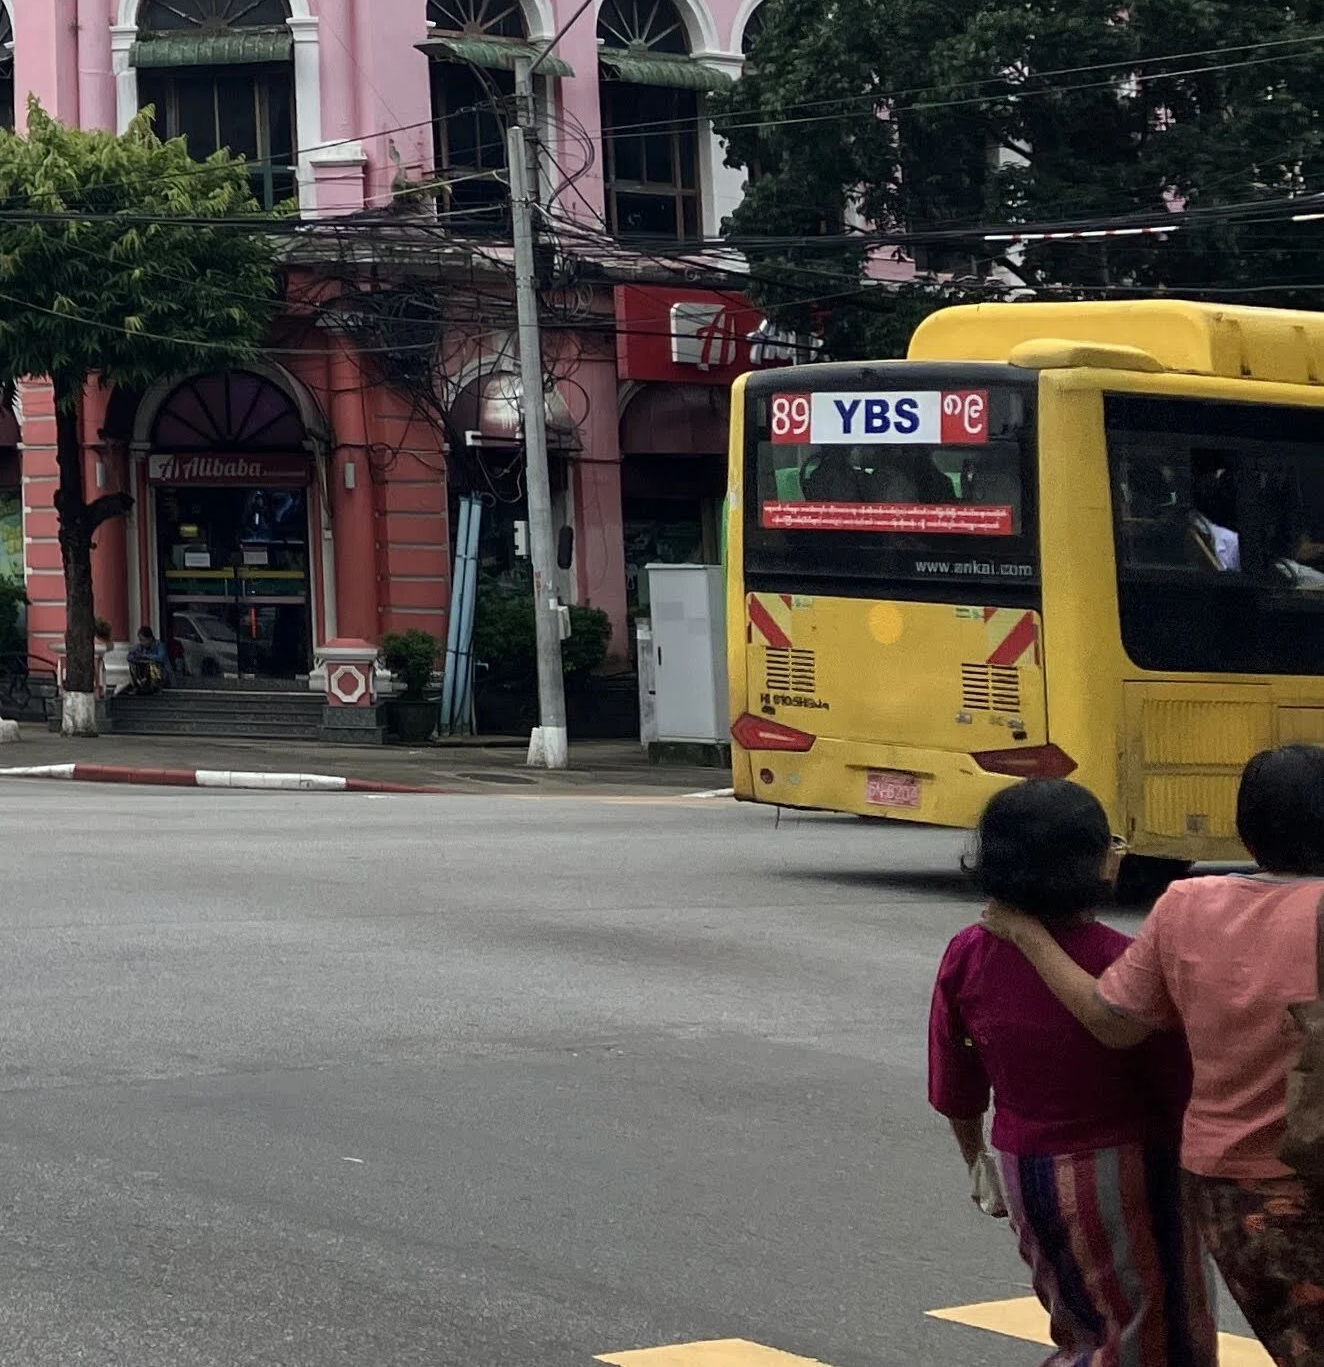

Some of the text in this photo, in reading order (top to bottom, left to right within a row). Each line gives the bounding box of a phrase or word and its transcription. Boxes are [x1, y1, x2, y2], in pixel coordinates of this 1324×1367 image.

[771, 397, 921, 435] 89 YBS
[183, 457, 261, 480] Alibaba
[915, 560, 1033, 576] www.ankai.com
